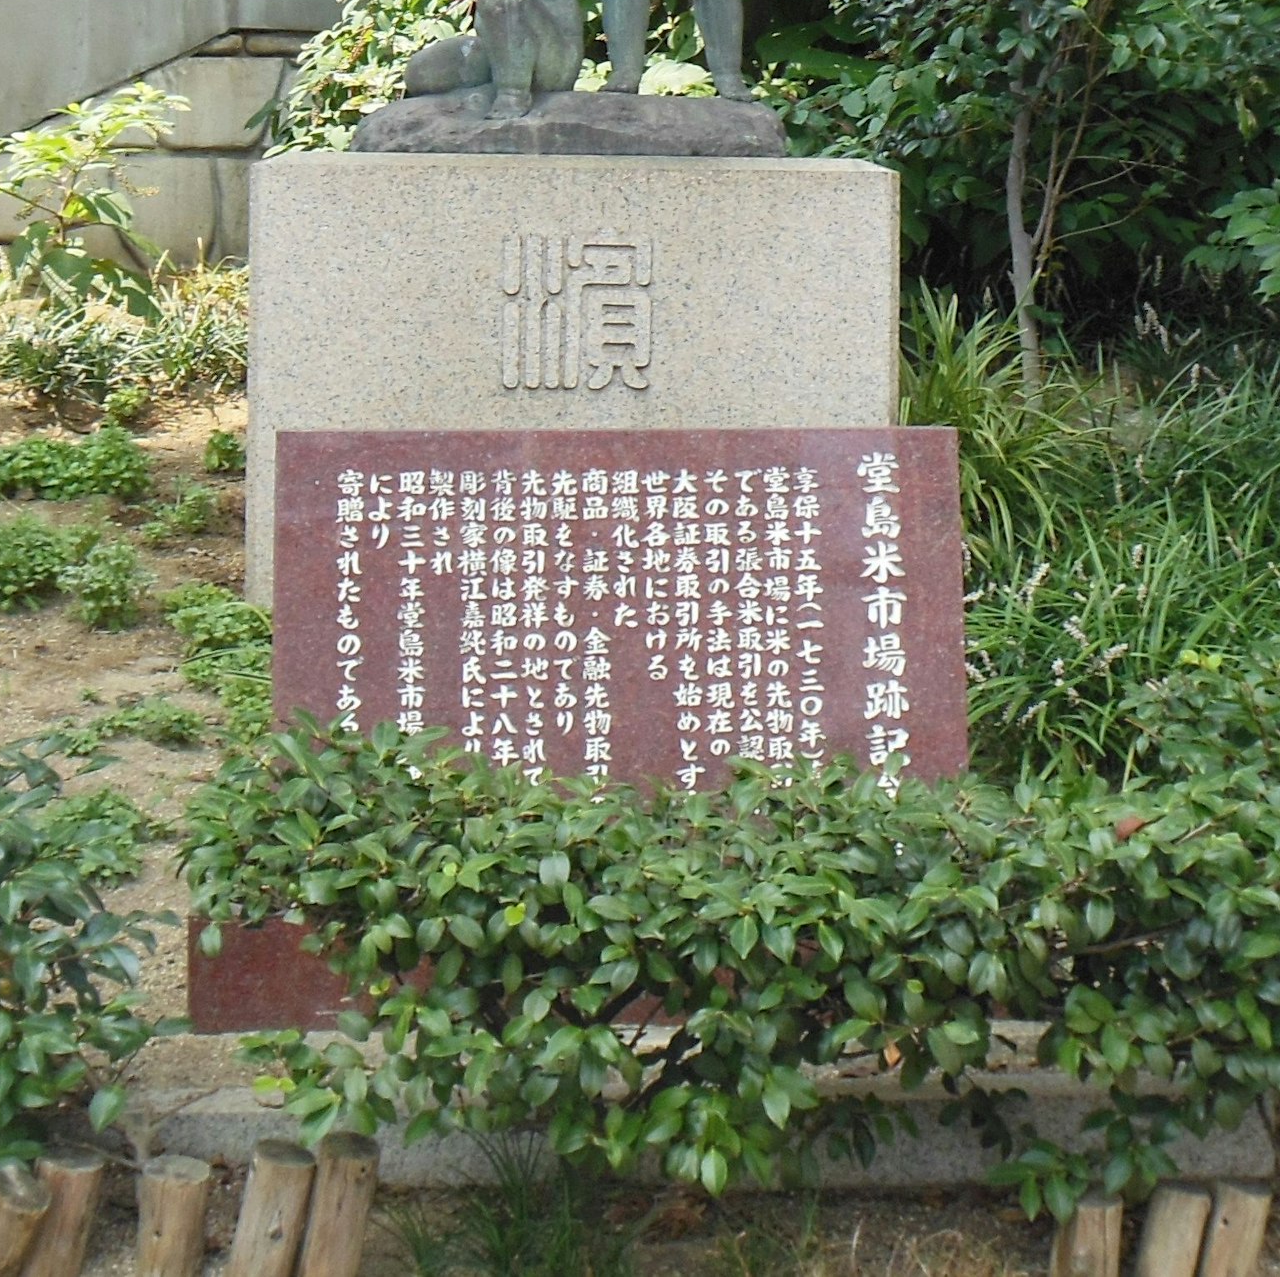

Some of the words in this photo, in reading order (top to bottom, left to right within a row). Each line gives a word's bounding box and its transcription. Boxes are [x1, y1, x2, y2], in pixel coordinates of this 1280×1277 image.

[367, 473, 394, 550] により
[427, 467, 457, 576] 製作され
[488, 468, 520, 769] 背後の像は昭和二十八年
[547, 468, 580, 736] 先駆をなすものであり
[609, 468, 641, 629] 組織化された
[639, 469, 672, 681] 世界各地における
[702, 468, 738, 759] その取引の手法は現在の
[671, 467, 710, 798] 大阪証券取引所を始めとす
